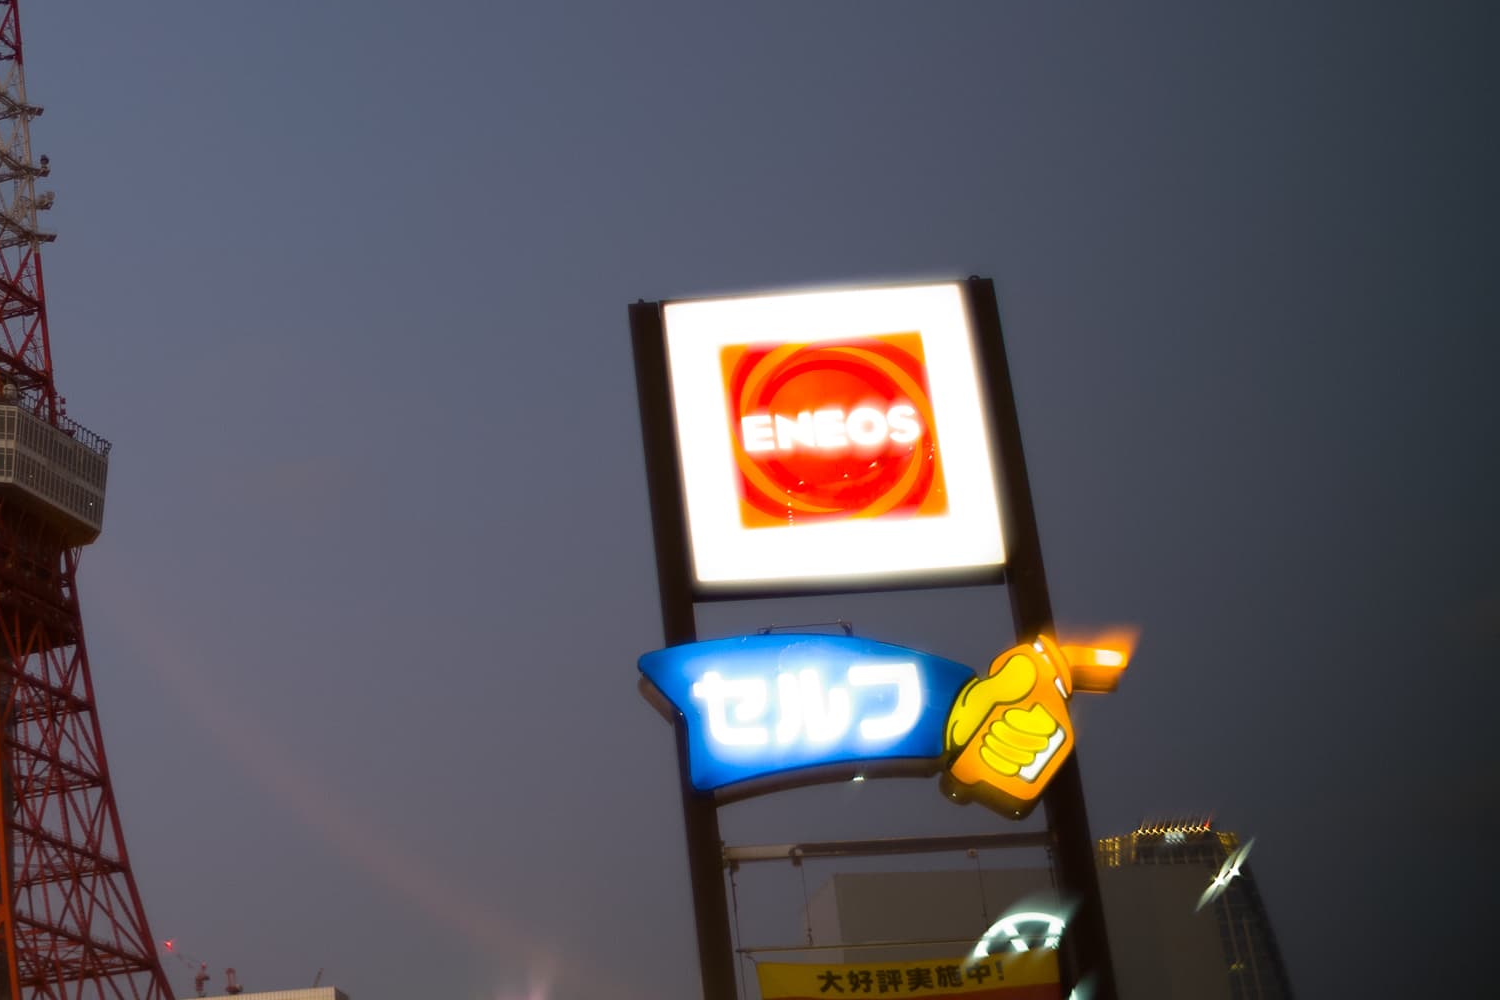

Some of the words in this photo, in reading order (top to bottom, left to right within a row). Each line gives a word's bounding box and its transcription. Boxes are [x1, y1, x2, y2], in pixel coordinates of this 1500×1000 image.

[740, 404, 921, 452] ENEOS
[692, 661, 924, 746] セルフ
